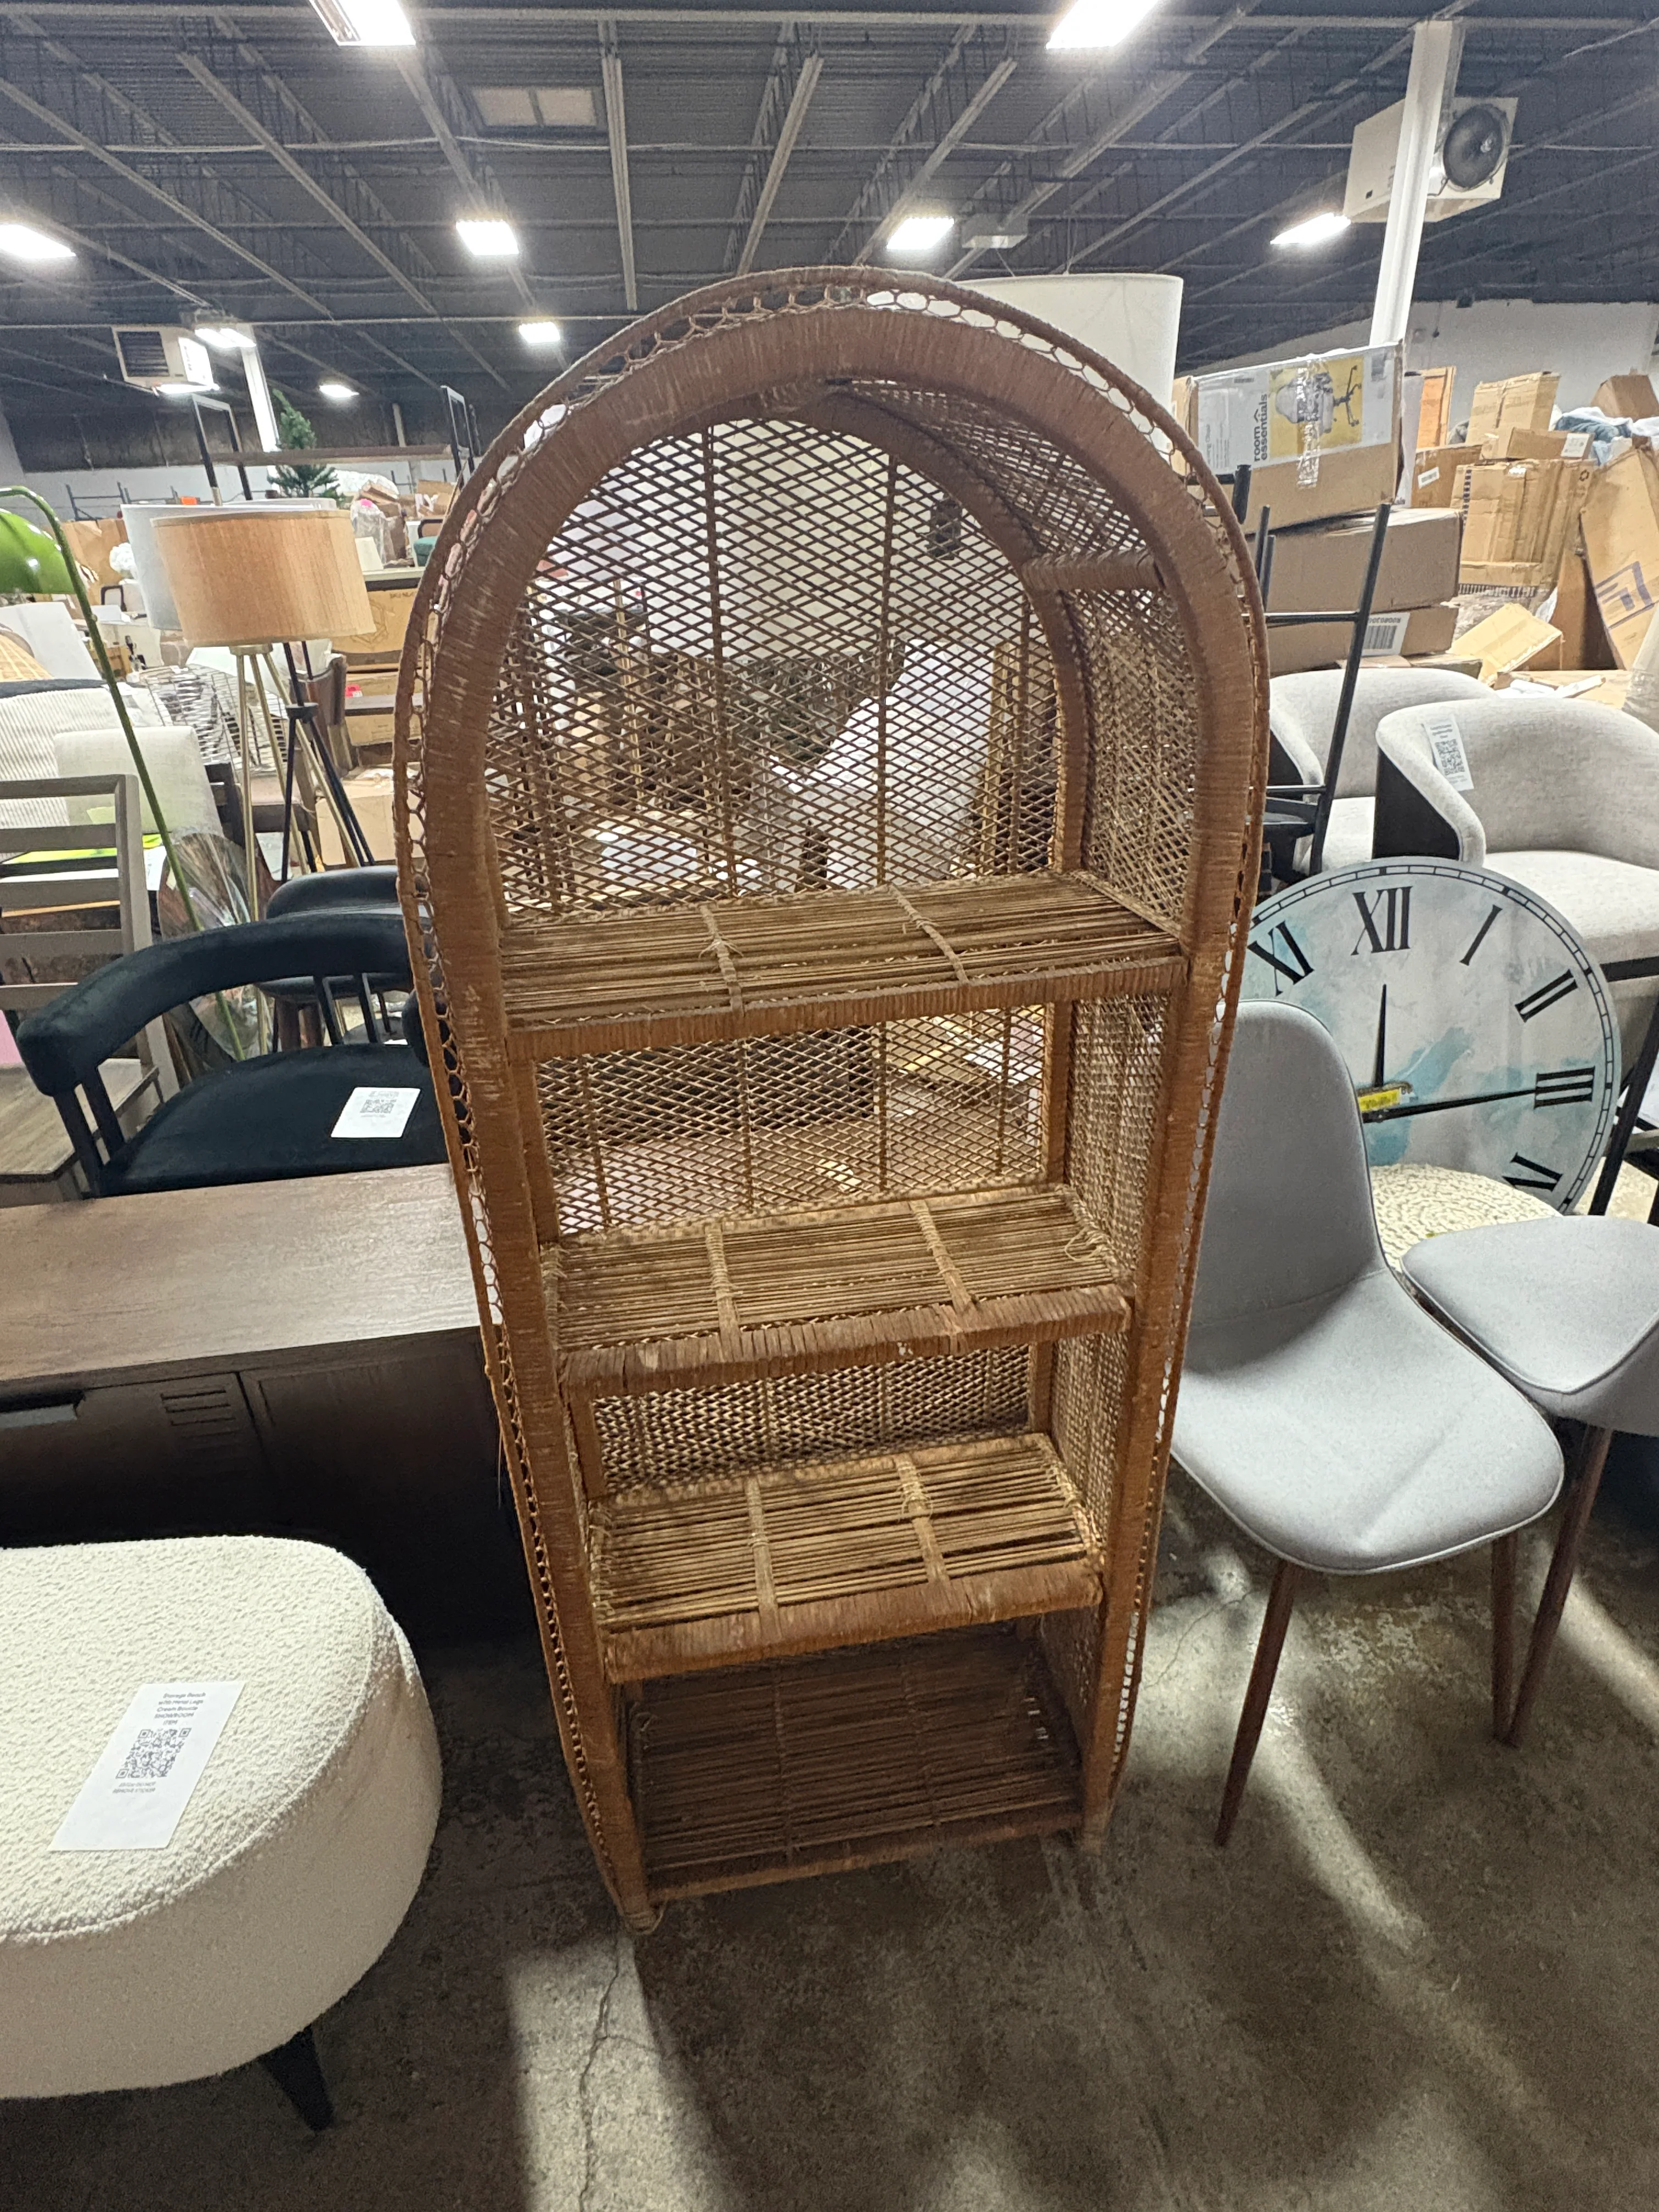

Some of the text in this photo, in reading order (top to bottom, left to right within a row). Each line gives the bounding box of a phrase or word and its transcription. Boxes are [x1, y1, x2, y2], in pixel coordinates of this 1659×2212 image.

[1259, 394, 1267, 461] essentials
[1351, 886, 1413, 956] XII
[1459, 904, 1503, 966] I
[1246, 921, 1314, 996] XI
[1514, 969, 1578, 1023] II
[1534, 1066, 1595, 1110] III
